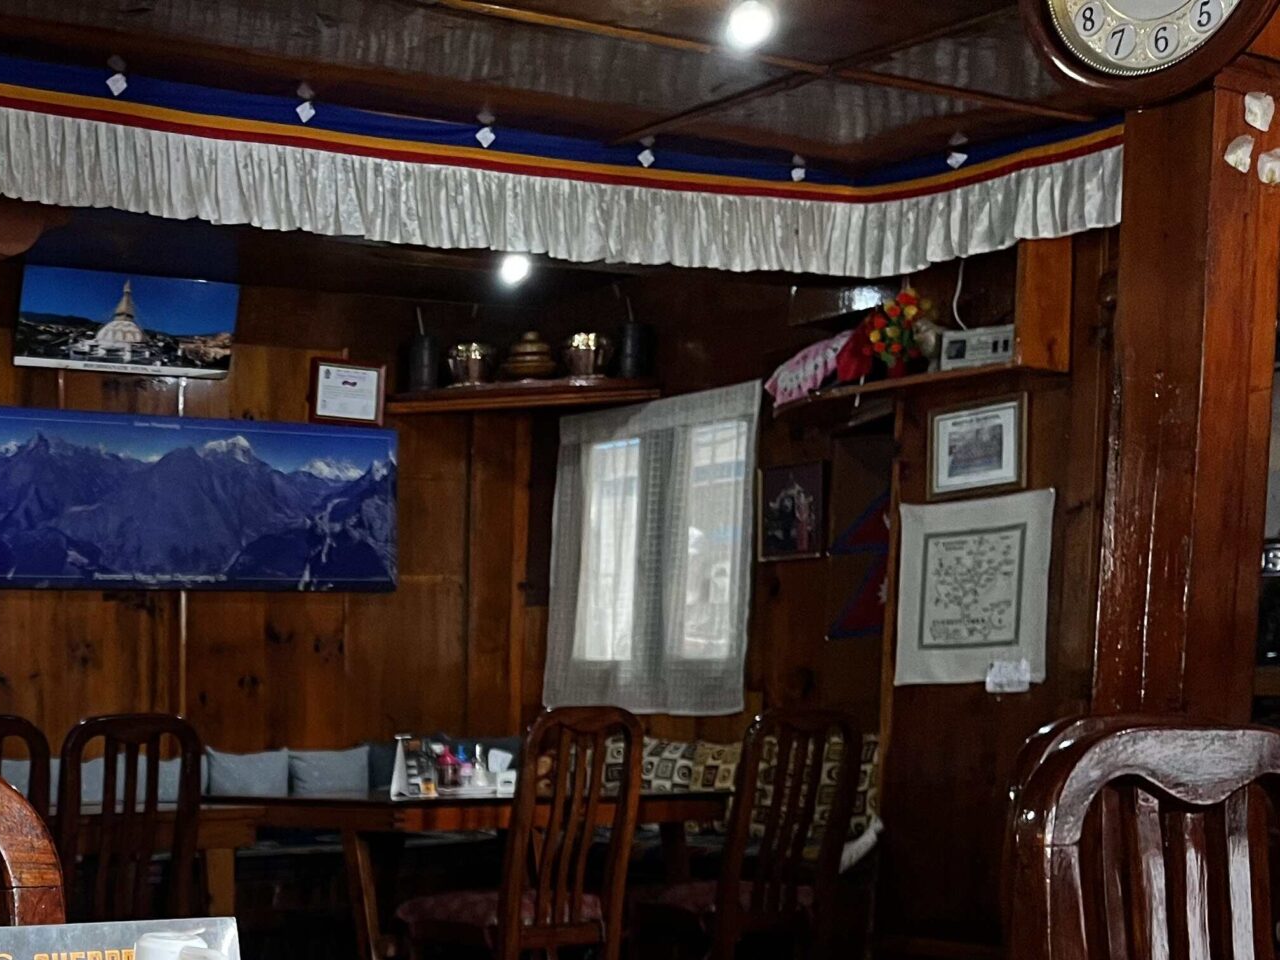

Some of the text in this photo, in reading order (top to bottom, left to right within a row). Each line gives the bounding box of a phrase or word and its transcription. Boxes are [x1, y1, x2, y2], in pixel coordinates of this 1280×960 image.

[1082, 7, 1095, 31] 8
[1197, 0, 1211, 27] 5
[1111, 28, 1125, 55] 7
[1154, 26, 1168, 53] 6
